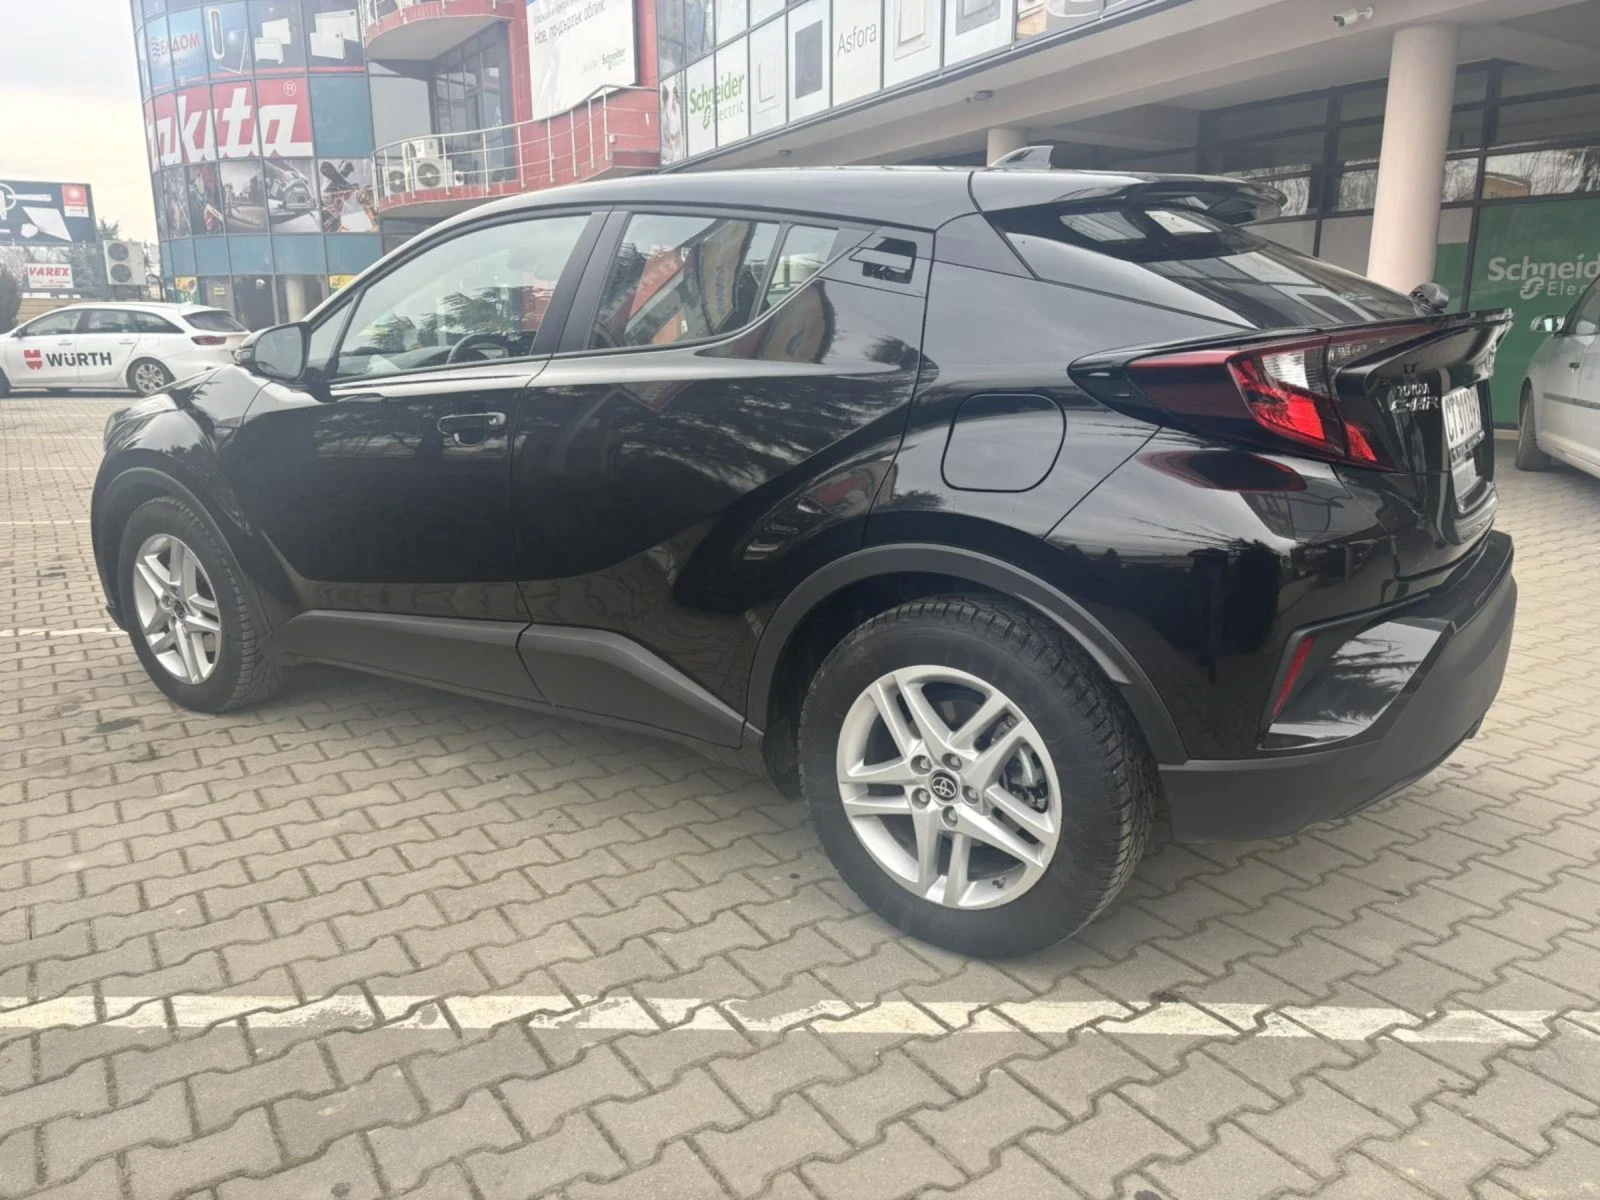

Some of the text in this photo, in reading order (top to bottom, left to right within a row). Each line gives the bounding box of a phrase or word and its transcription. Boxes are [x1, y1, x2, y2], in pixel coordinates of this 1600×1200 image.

[837, 24, 876, 58] Asfora
[690, 72, 744, 114] Schneider
[28, 267, 69, 277] VAREX
[45, 352, 113, 367] WÜRTH
